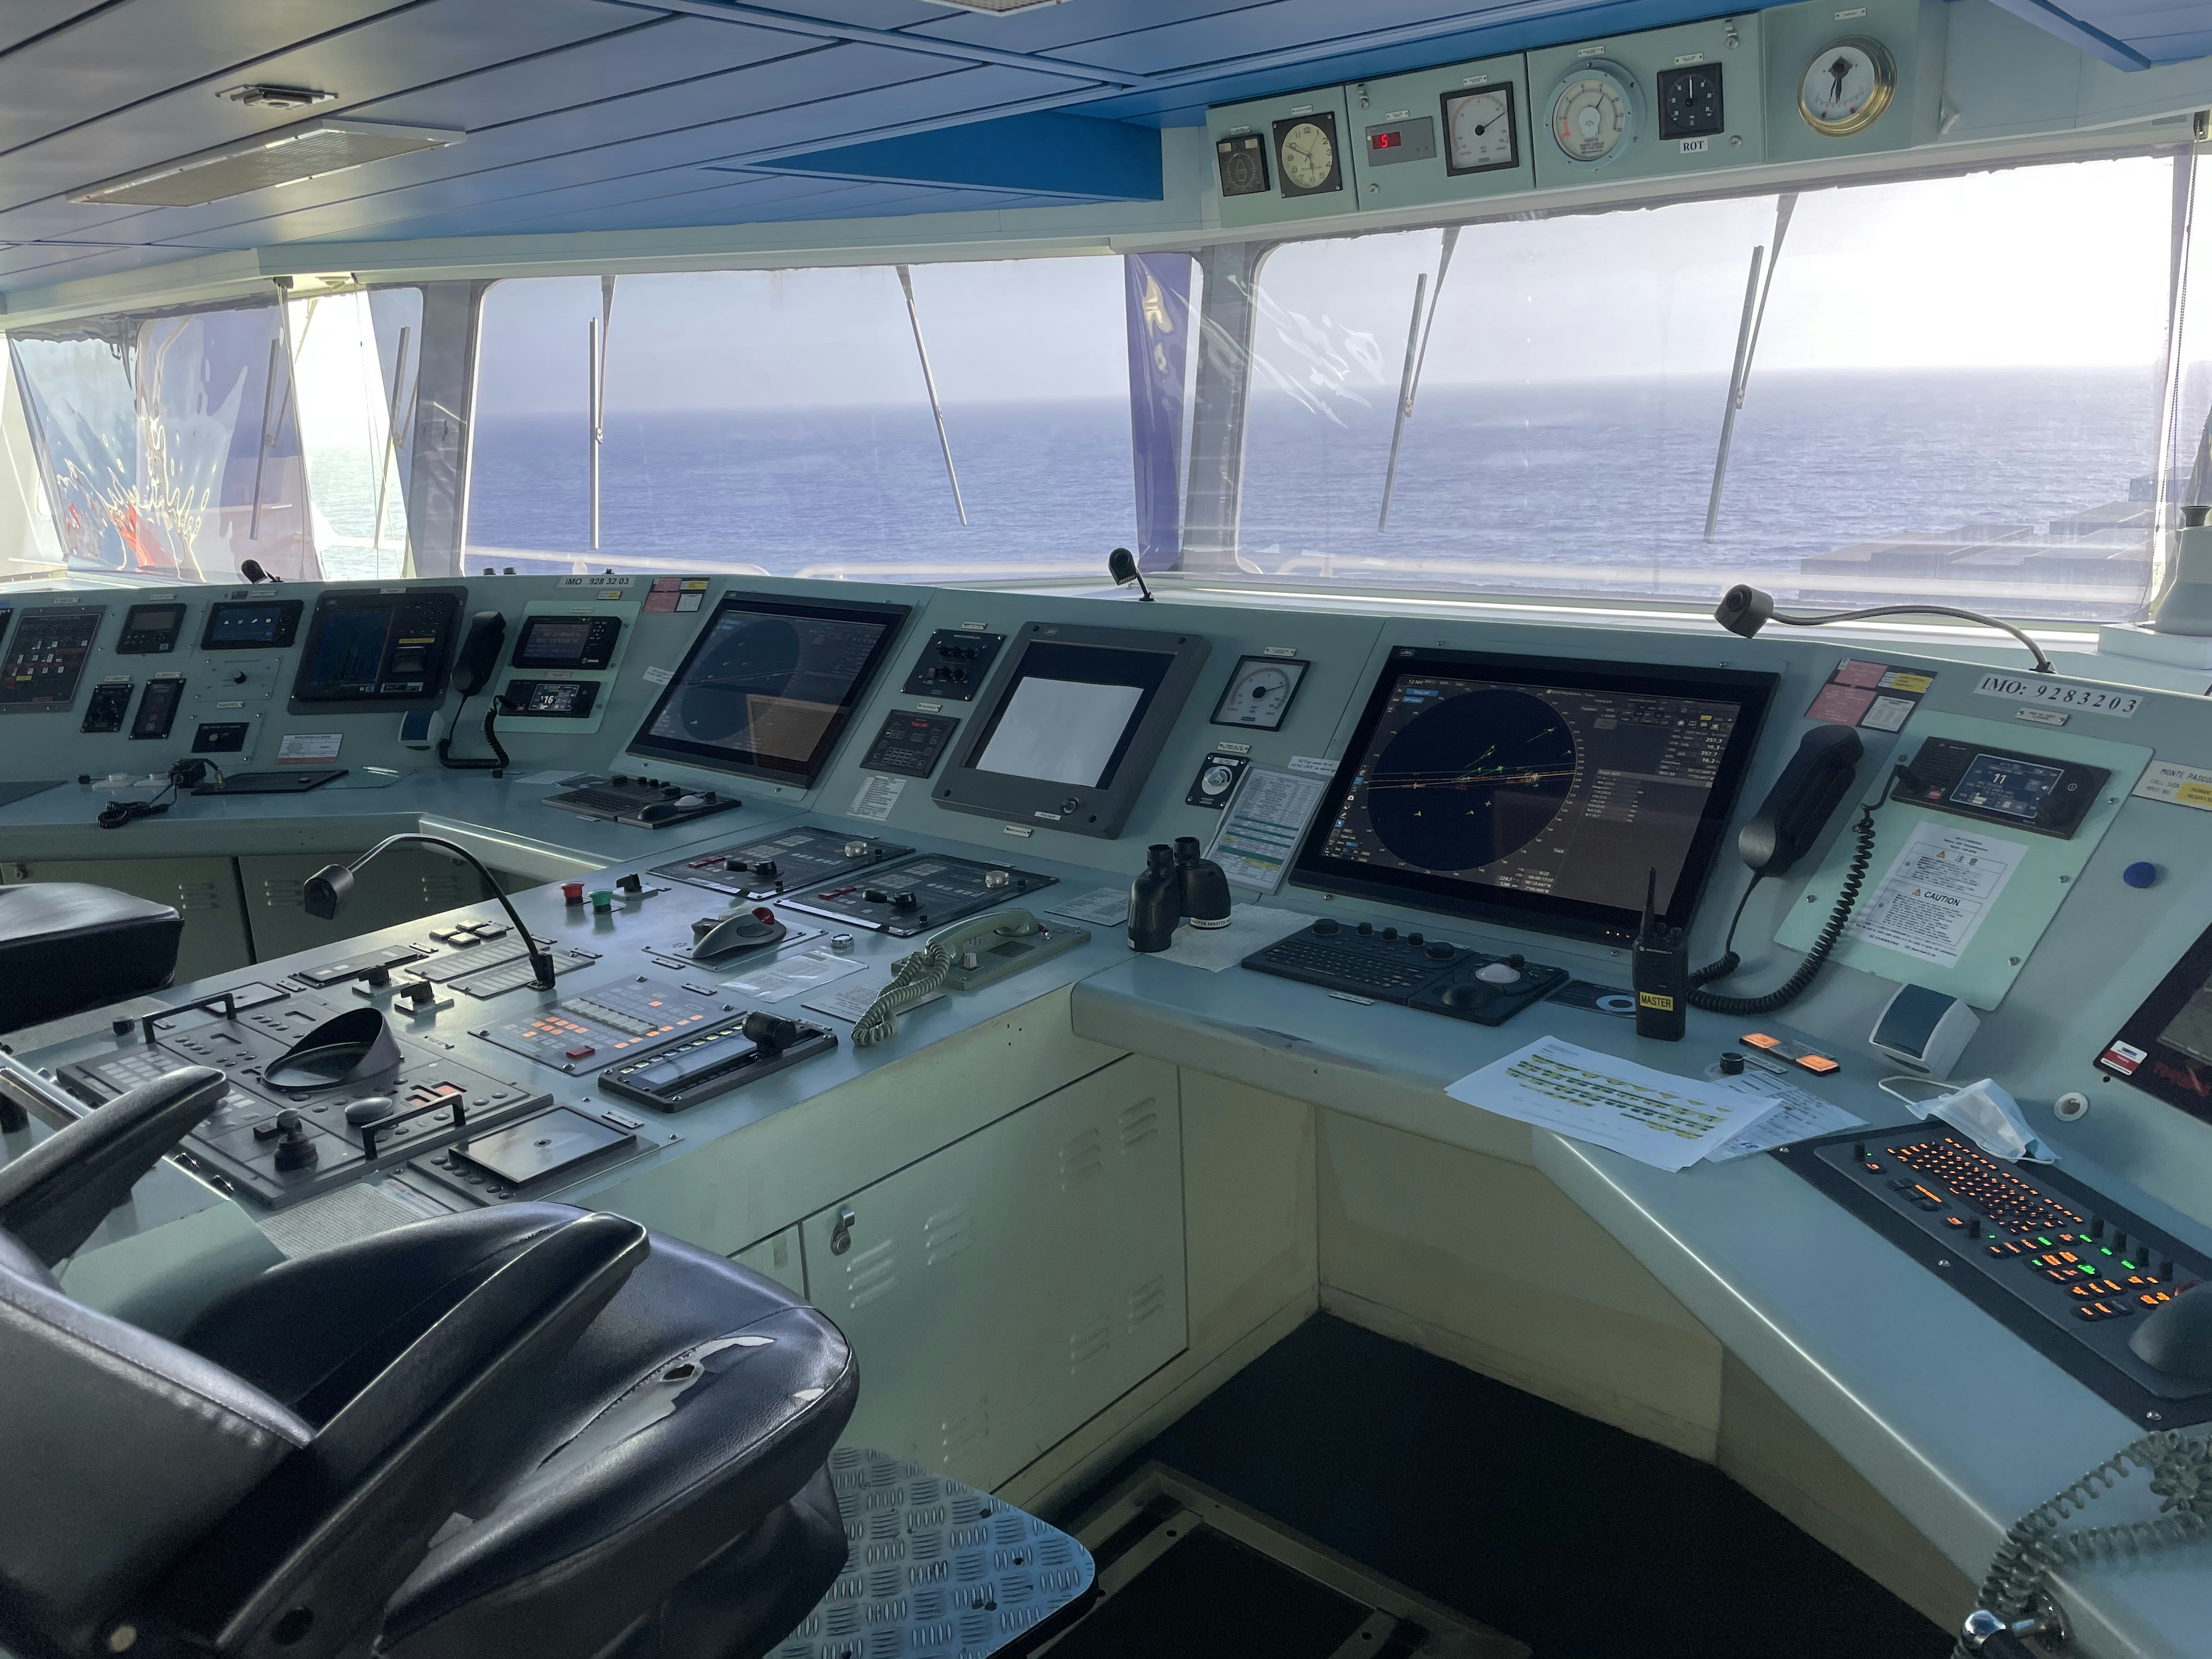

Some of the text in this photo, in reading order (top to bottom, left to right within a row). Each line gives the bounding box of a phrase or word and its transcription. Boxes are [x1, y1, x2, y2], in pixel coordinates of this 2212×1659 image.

[1683, 140, 1704, 151] ROT
[543, 695, 554, 704] 16
[1981, 677, 2137, 713] IMO: 9283203
[1993, 772, 2007, 785] 11
[2160, 768, 2185, 778] MONTE
[1924, 891, 1961, 907] CAUTION
[1190, 918, 1207, 927] MASTER
[1641, 995, 1672, 1008] MASTER
